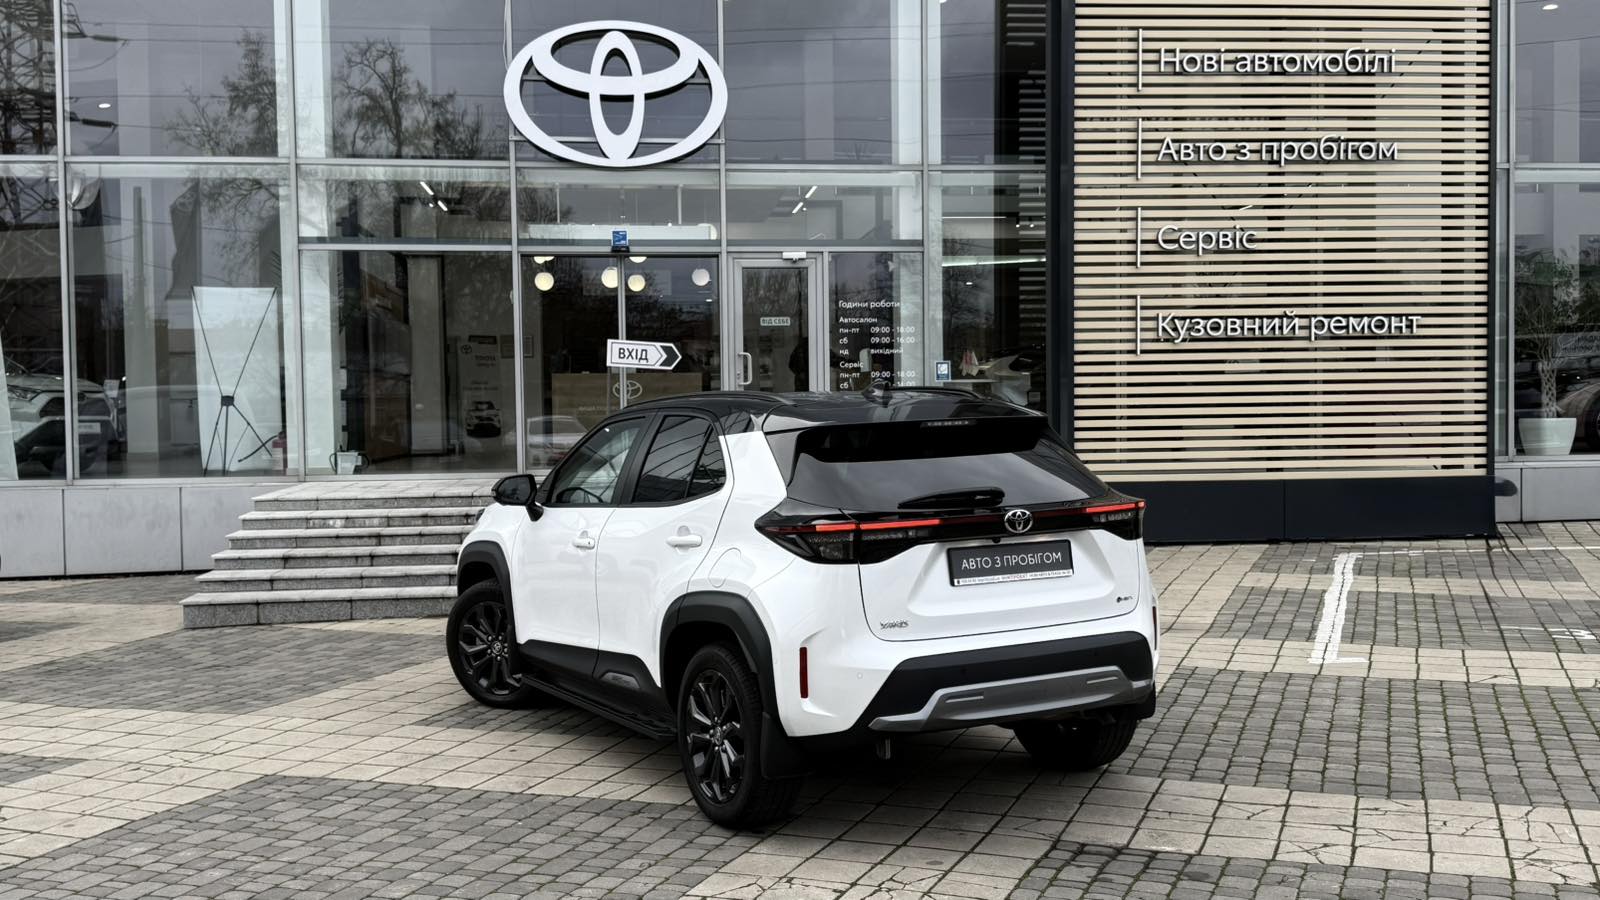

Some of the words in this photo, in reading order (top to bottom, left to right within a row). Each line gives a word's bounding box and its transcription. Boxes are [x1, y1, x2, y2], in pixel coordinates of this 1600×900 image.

[1159, 47, 1225, 73] Нові
[1235, 47, 1396, 73] автомобілі
[1157, 136, 1227, 161] Авто
[1235, 141, 1250, 161] з
[1261, 134, 1398, 167] пробігом
[1157, 224, 1257, 256] Сервіс
[839, 300, 868, 309] Години
[870, 300, 900, 309] роботи
[1157, 310, 1299, 343] Кузовний
[1310, 315, 1421, 342] ремонт
[618, 347, 649, 364] ВХІД
[961, 557, 992, 570] АВТО
[1003, 552, 1062, 566] ПРОБІГОМ
